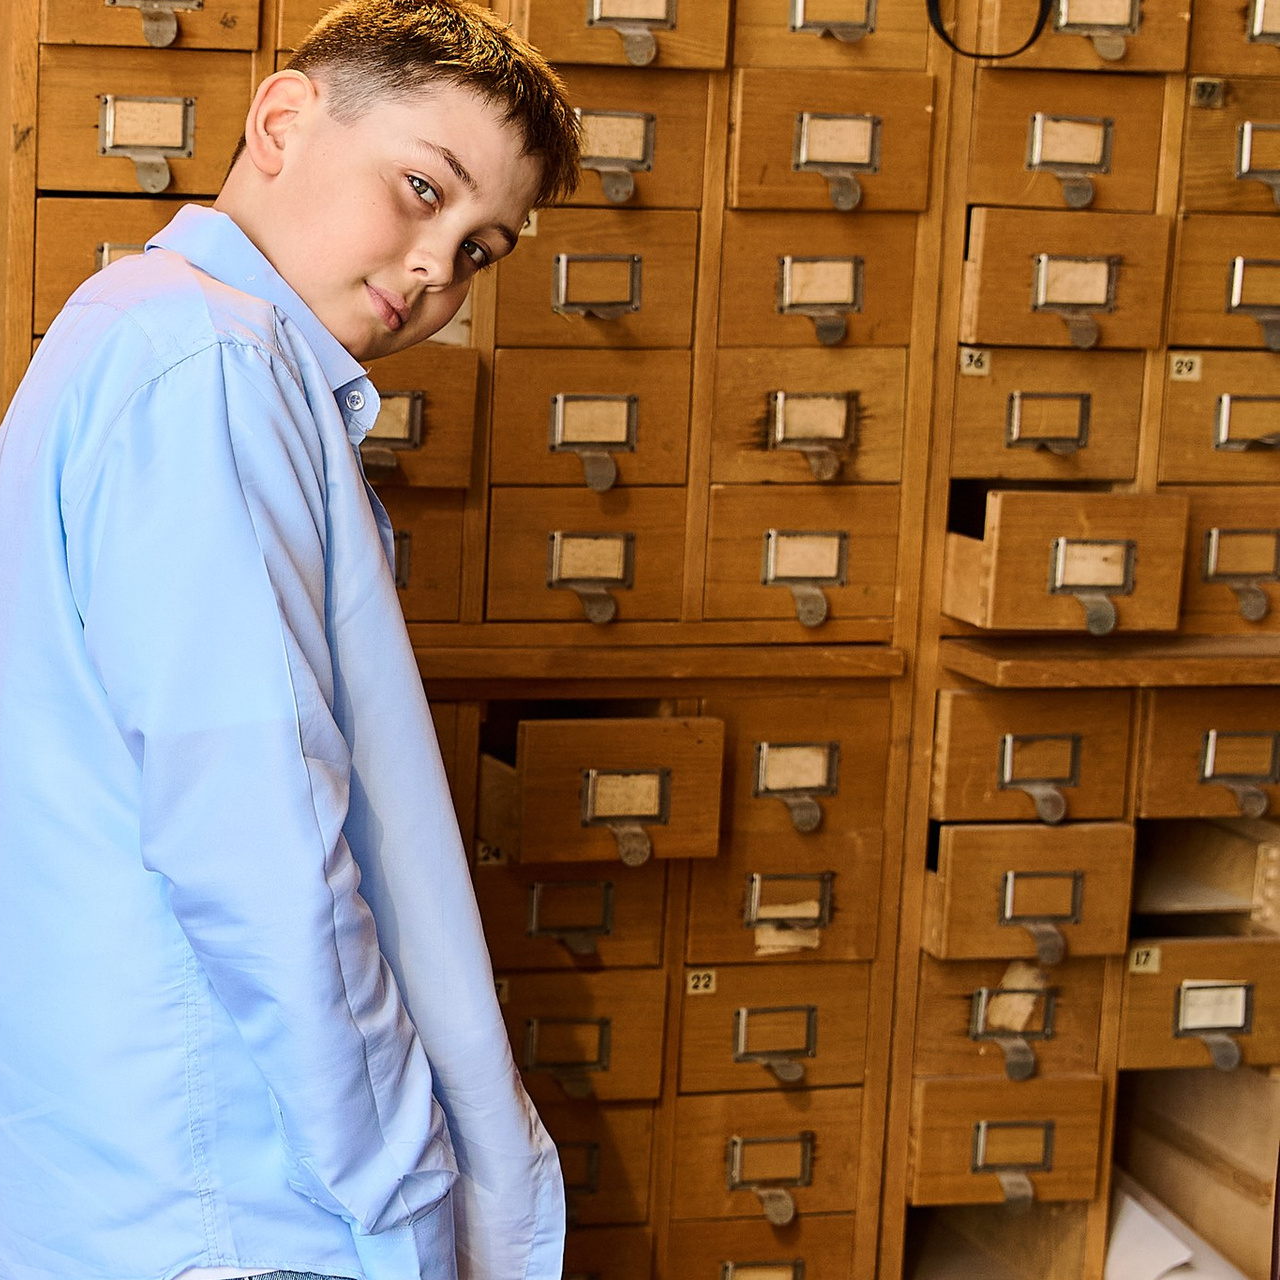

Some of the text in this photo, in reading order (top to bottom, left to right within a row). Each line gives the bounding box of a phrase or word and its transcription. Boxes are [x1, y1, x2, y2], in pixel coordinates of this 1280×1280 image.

[1175, 359, 1194, 375] 29
[1135, 950, 1151, 966] 17
[691, 973, 712, 990] 22
